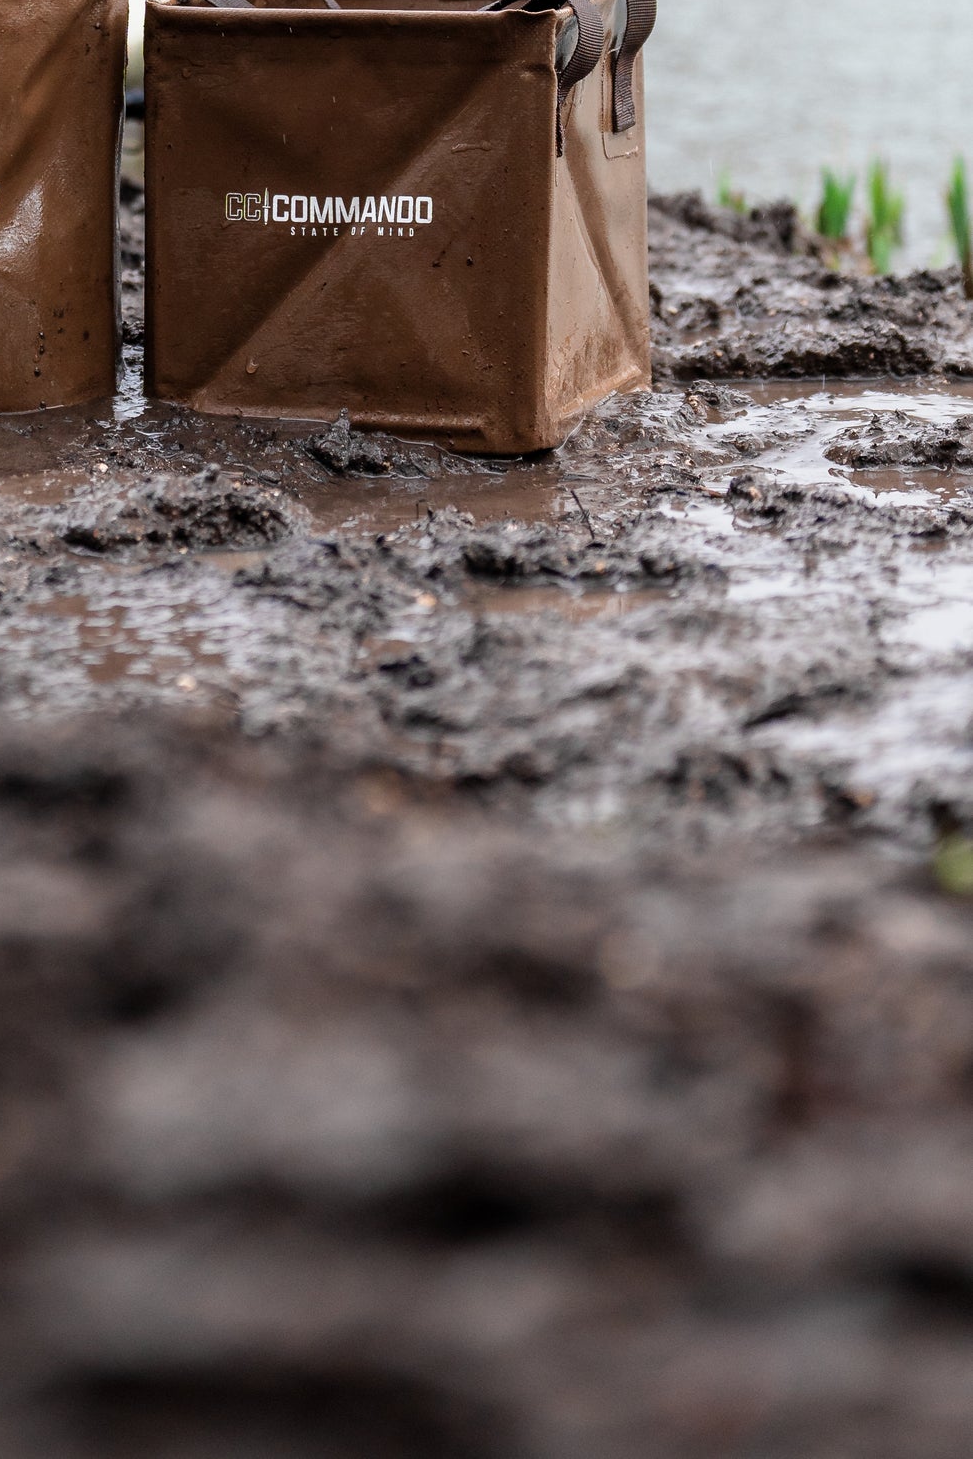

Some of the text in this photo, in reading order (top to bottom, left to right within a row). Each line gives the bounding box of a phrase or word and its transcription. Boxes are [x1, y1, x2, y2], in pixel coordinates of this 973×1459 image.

[225, 192, 433, 224] CC COMMANDO
[290, 226, 415, 237] STATE OF MIND
